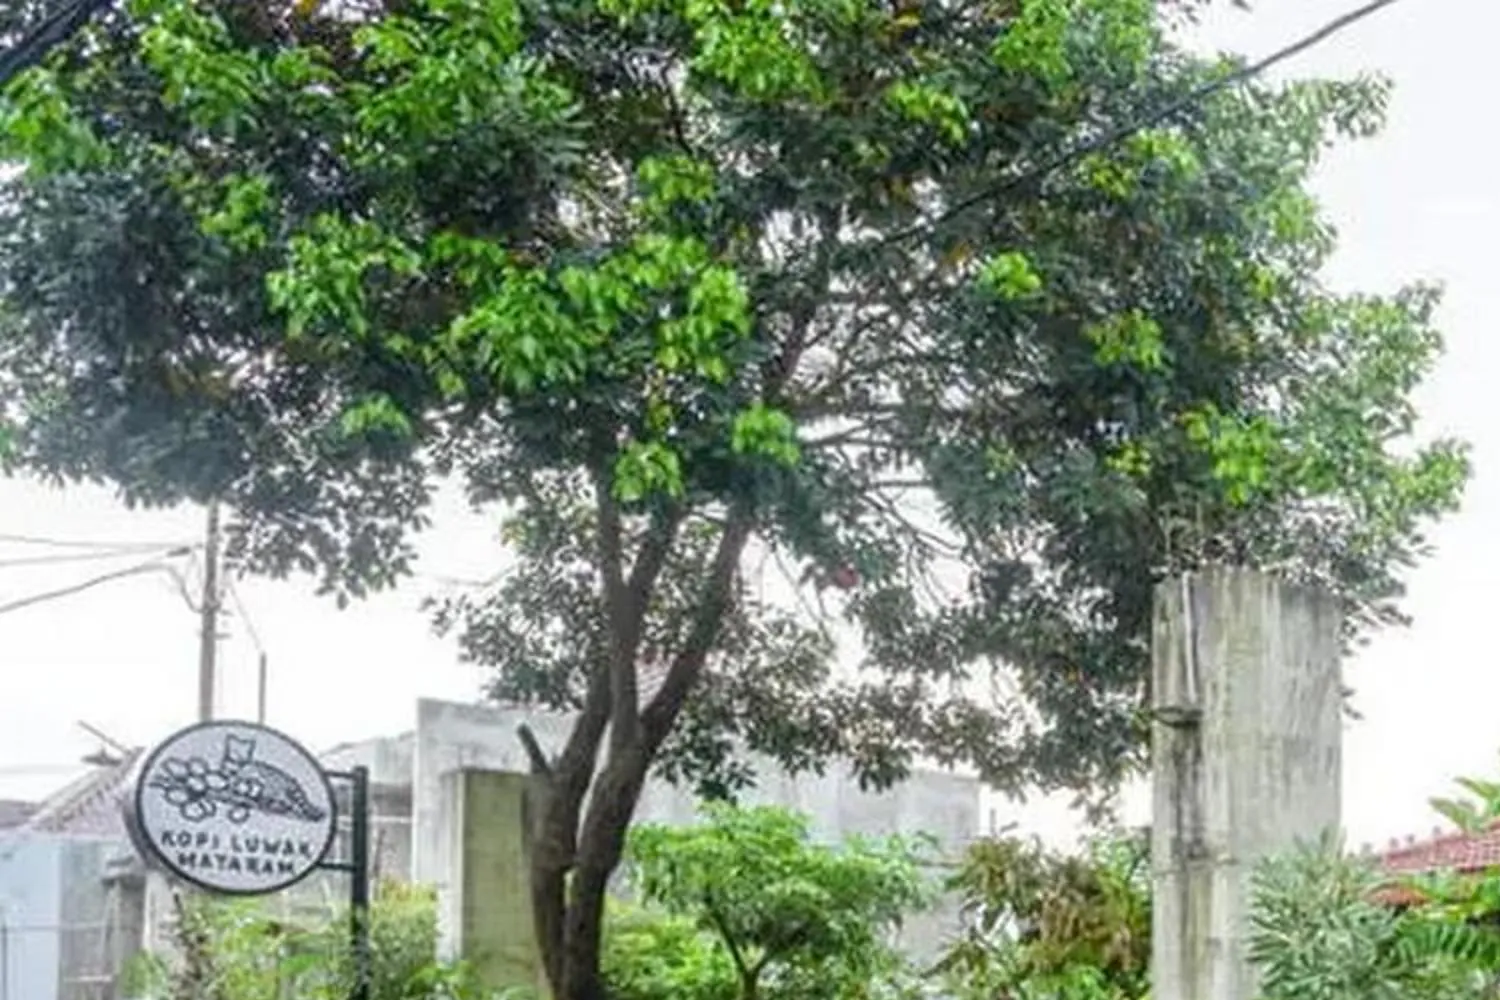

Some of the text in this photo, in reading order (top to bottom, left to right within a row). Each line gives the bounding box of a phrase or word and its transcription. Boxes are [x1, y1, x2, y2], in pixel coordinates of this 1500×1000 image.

[161, 830, 310, 857] KOPI LUWAK
[178, 853, 295, 874] MATARAM
